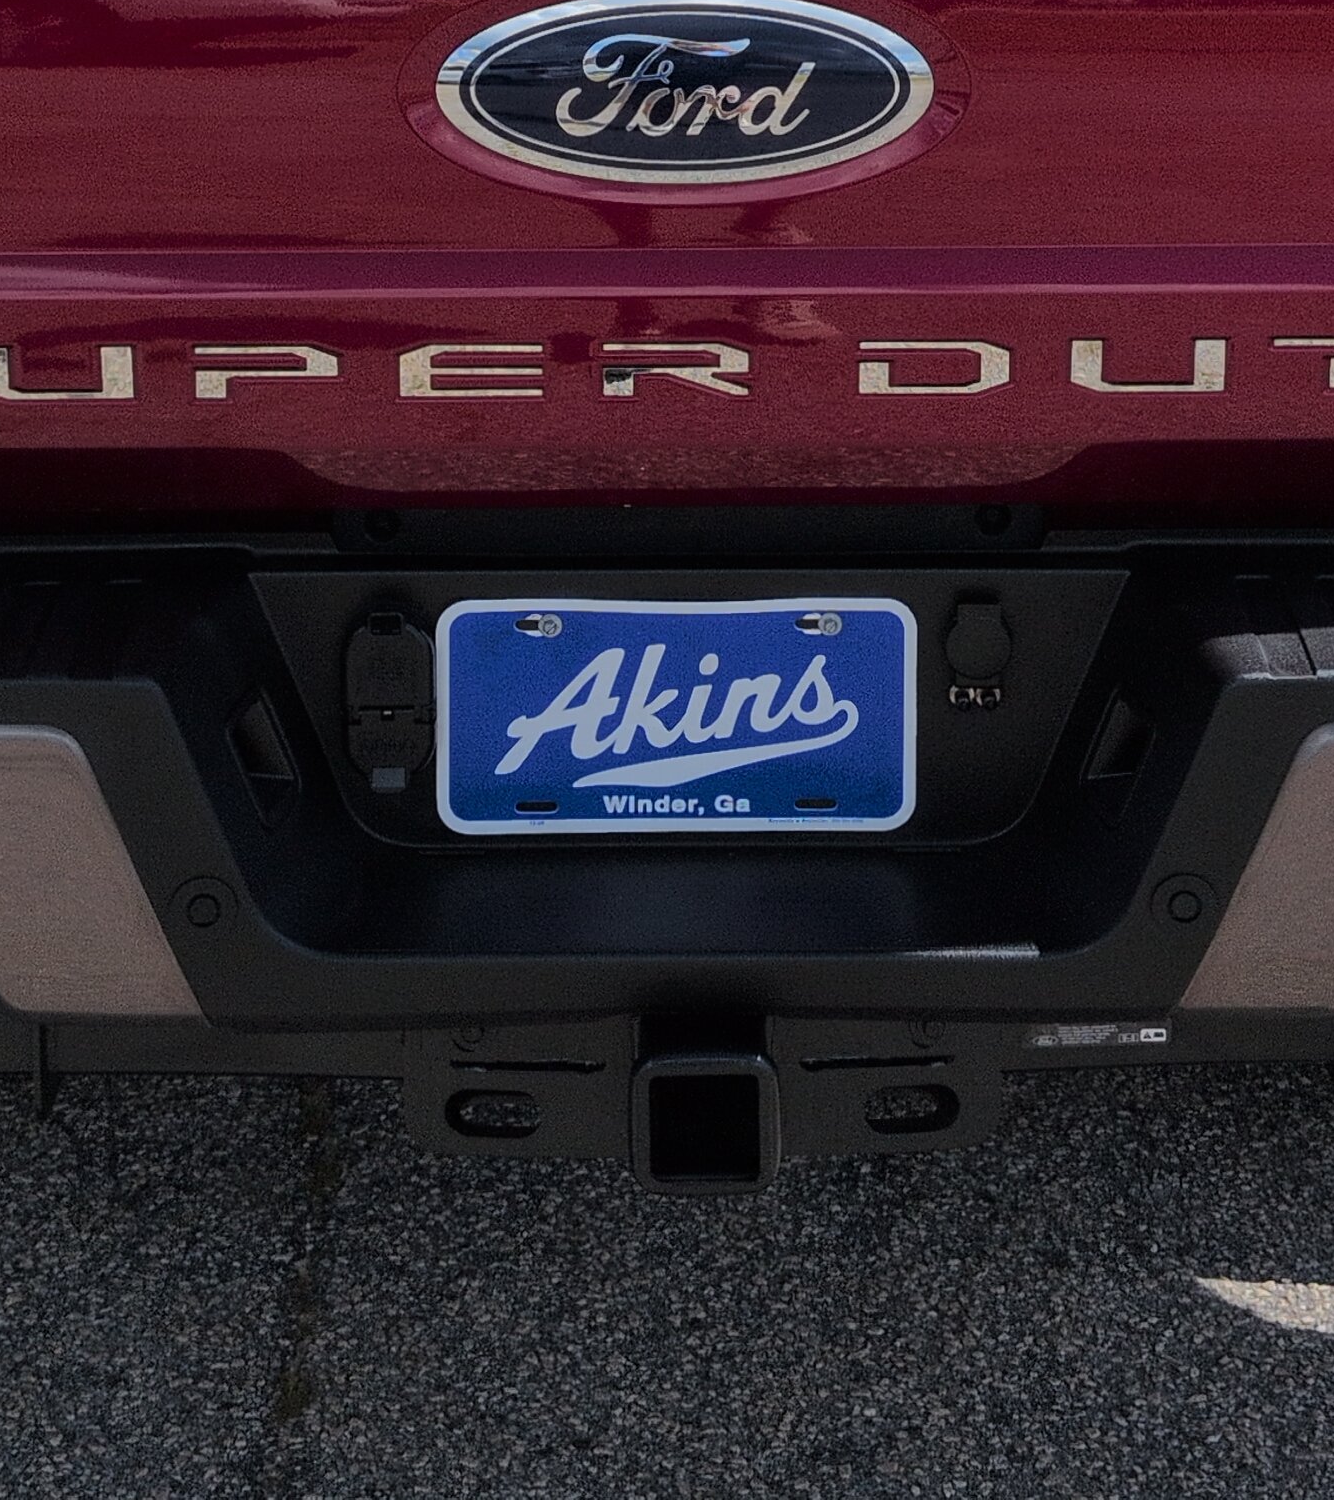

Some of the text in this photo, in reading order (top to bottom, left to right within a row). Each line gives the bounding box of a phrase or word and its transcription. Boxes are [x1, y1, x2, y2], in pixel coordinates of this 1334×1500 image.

[556, 33, 816, 137] Ford
[494, 643, 860, 788] Akins
[713, 794, 752, 813] Ga
